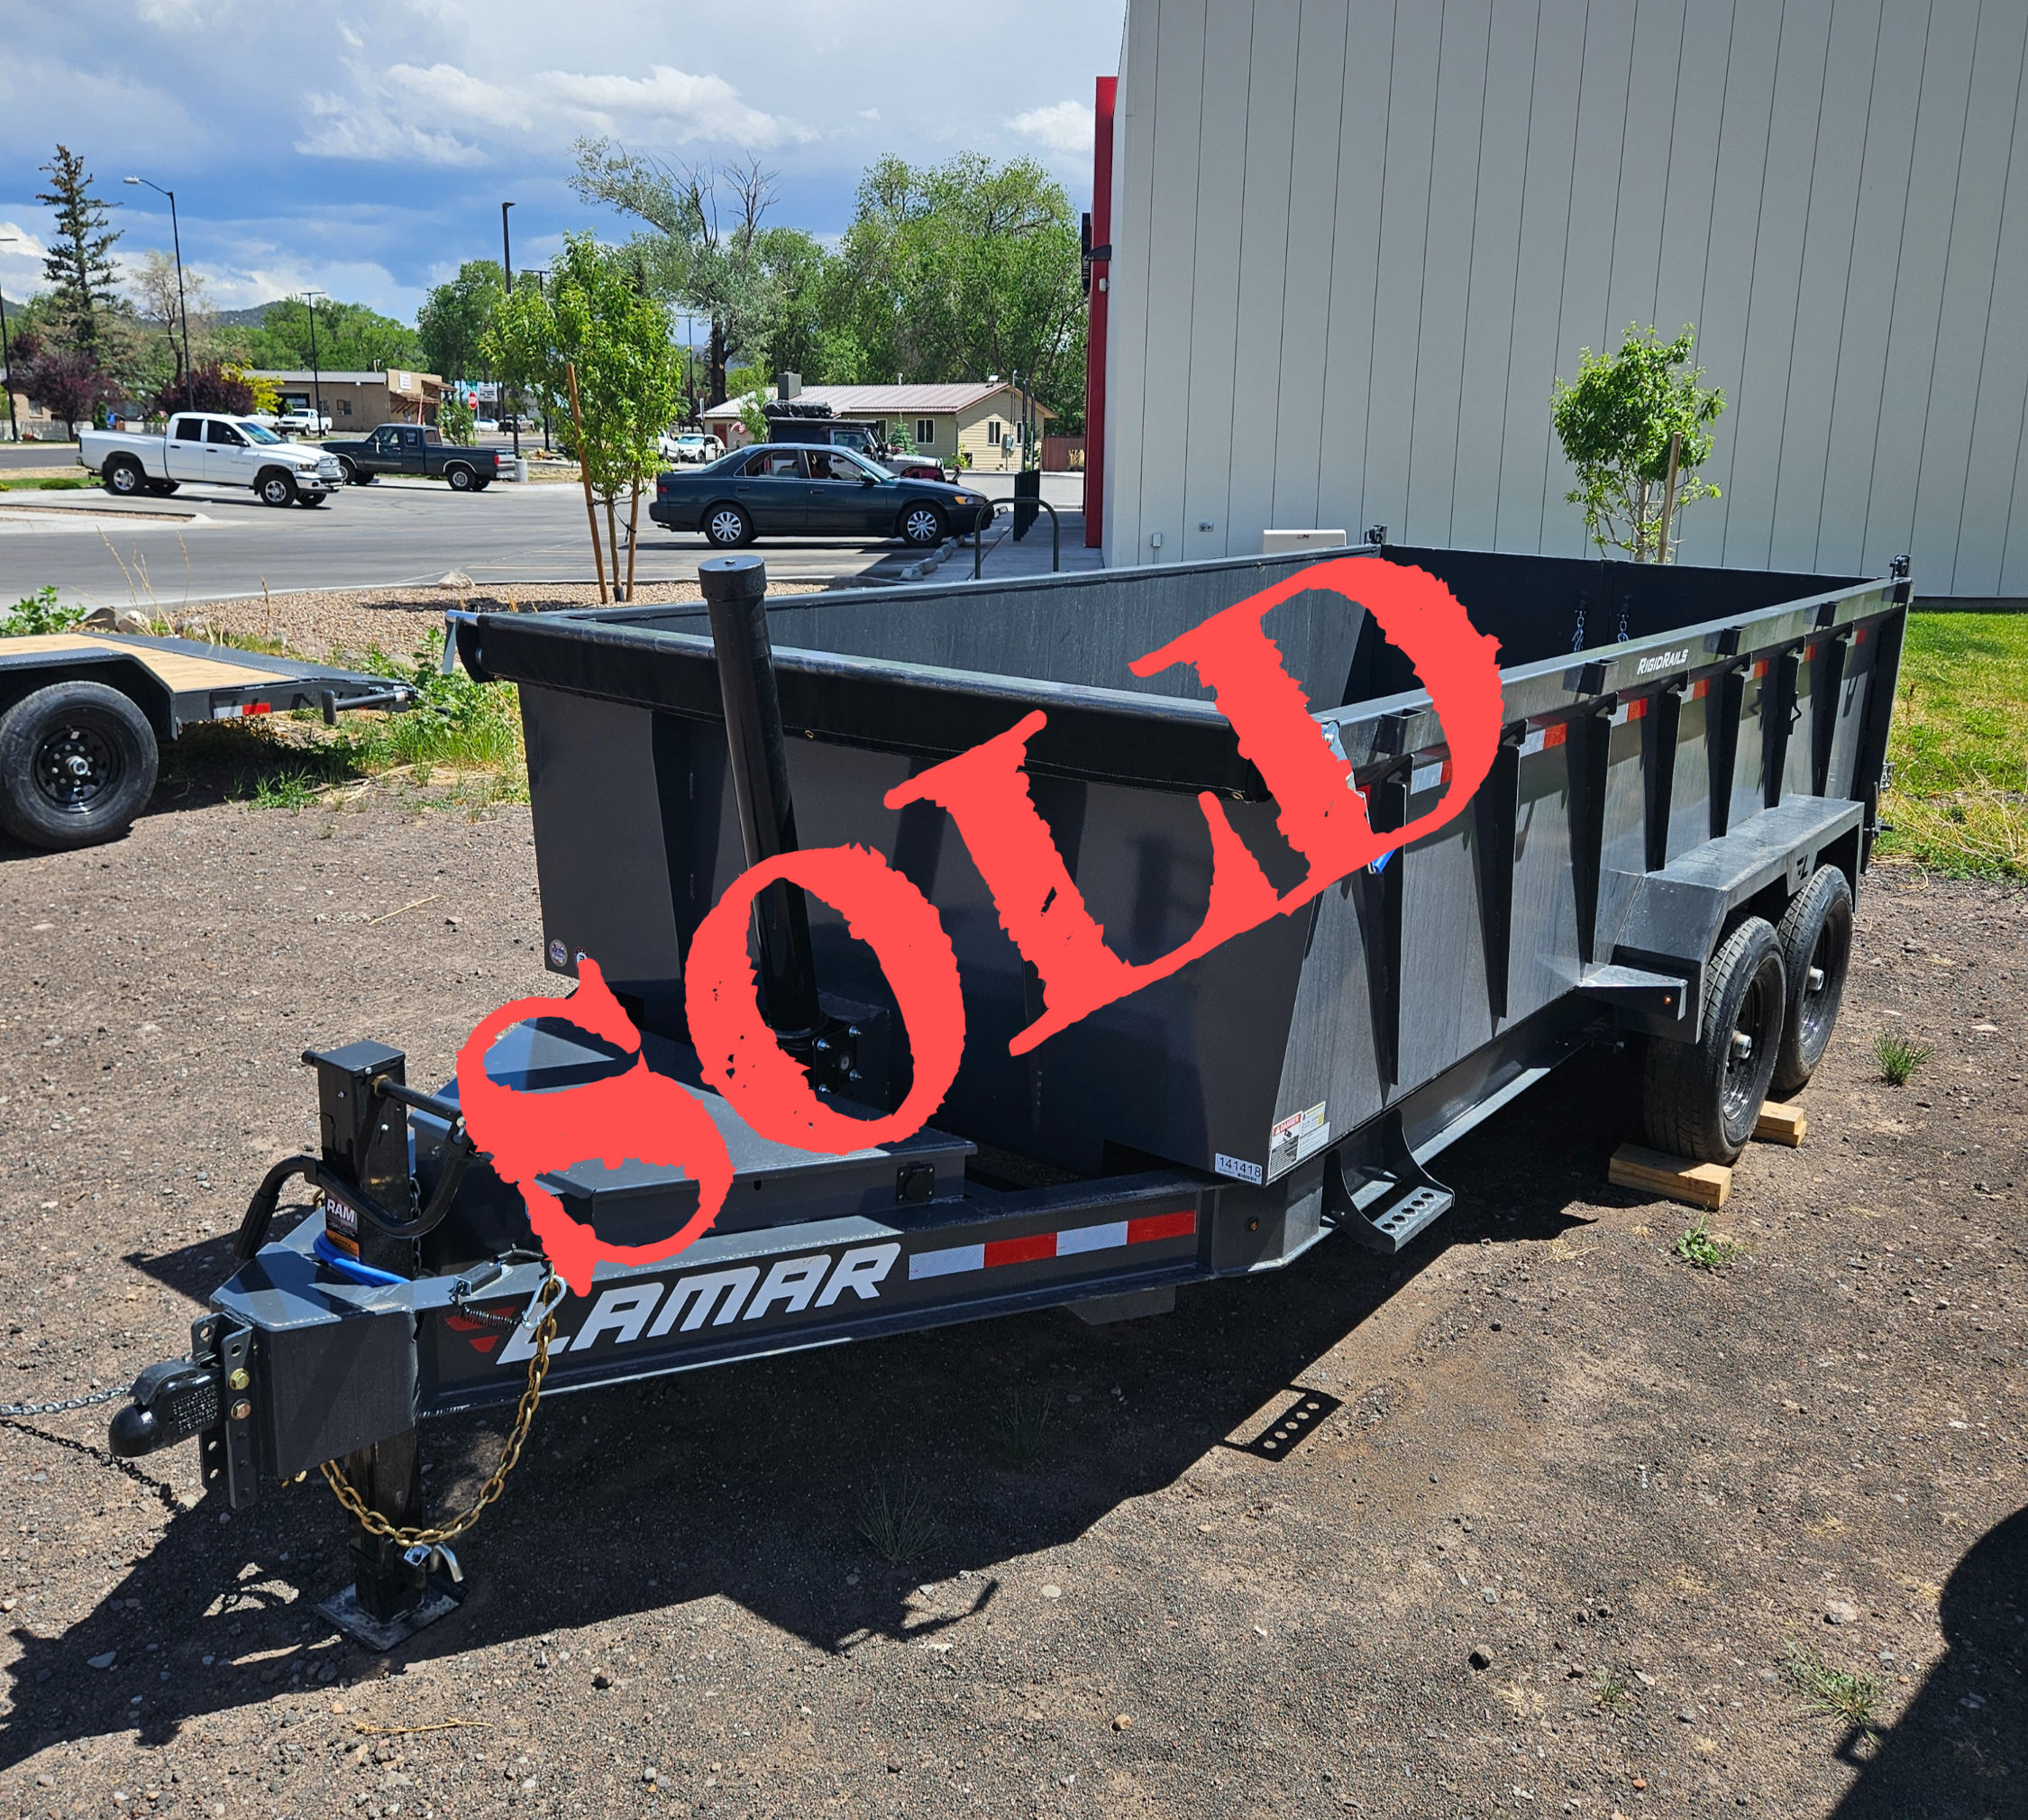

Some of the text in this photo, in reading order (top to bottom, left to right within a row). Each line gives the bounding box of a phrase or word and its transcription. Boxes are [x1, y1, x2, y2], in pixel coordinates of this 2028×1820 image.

[1220, 1157, 1261, 1178] 141418
[326, 1198, 356, 1223] RAM
[496, 1242, 901, 1365] LAMAR
